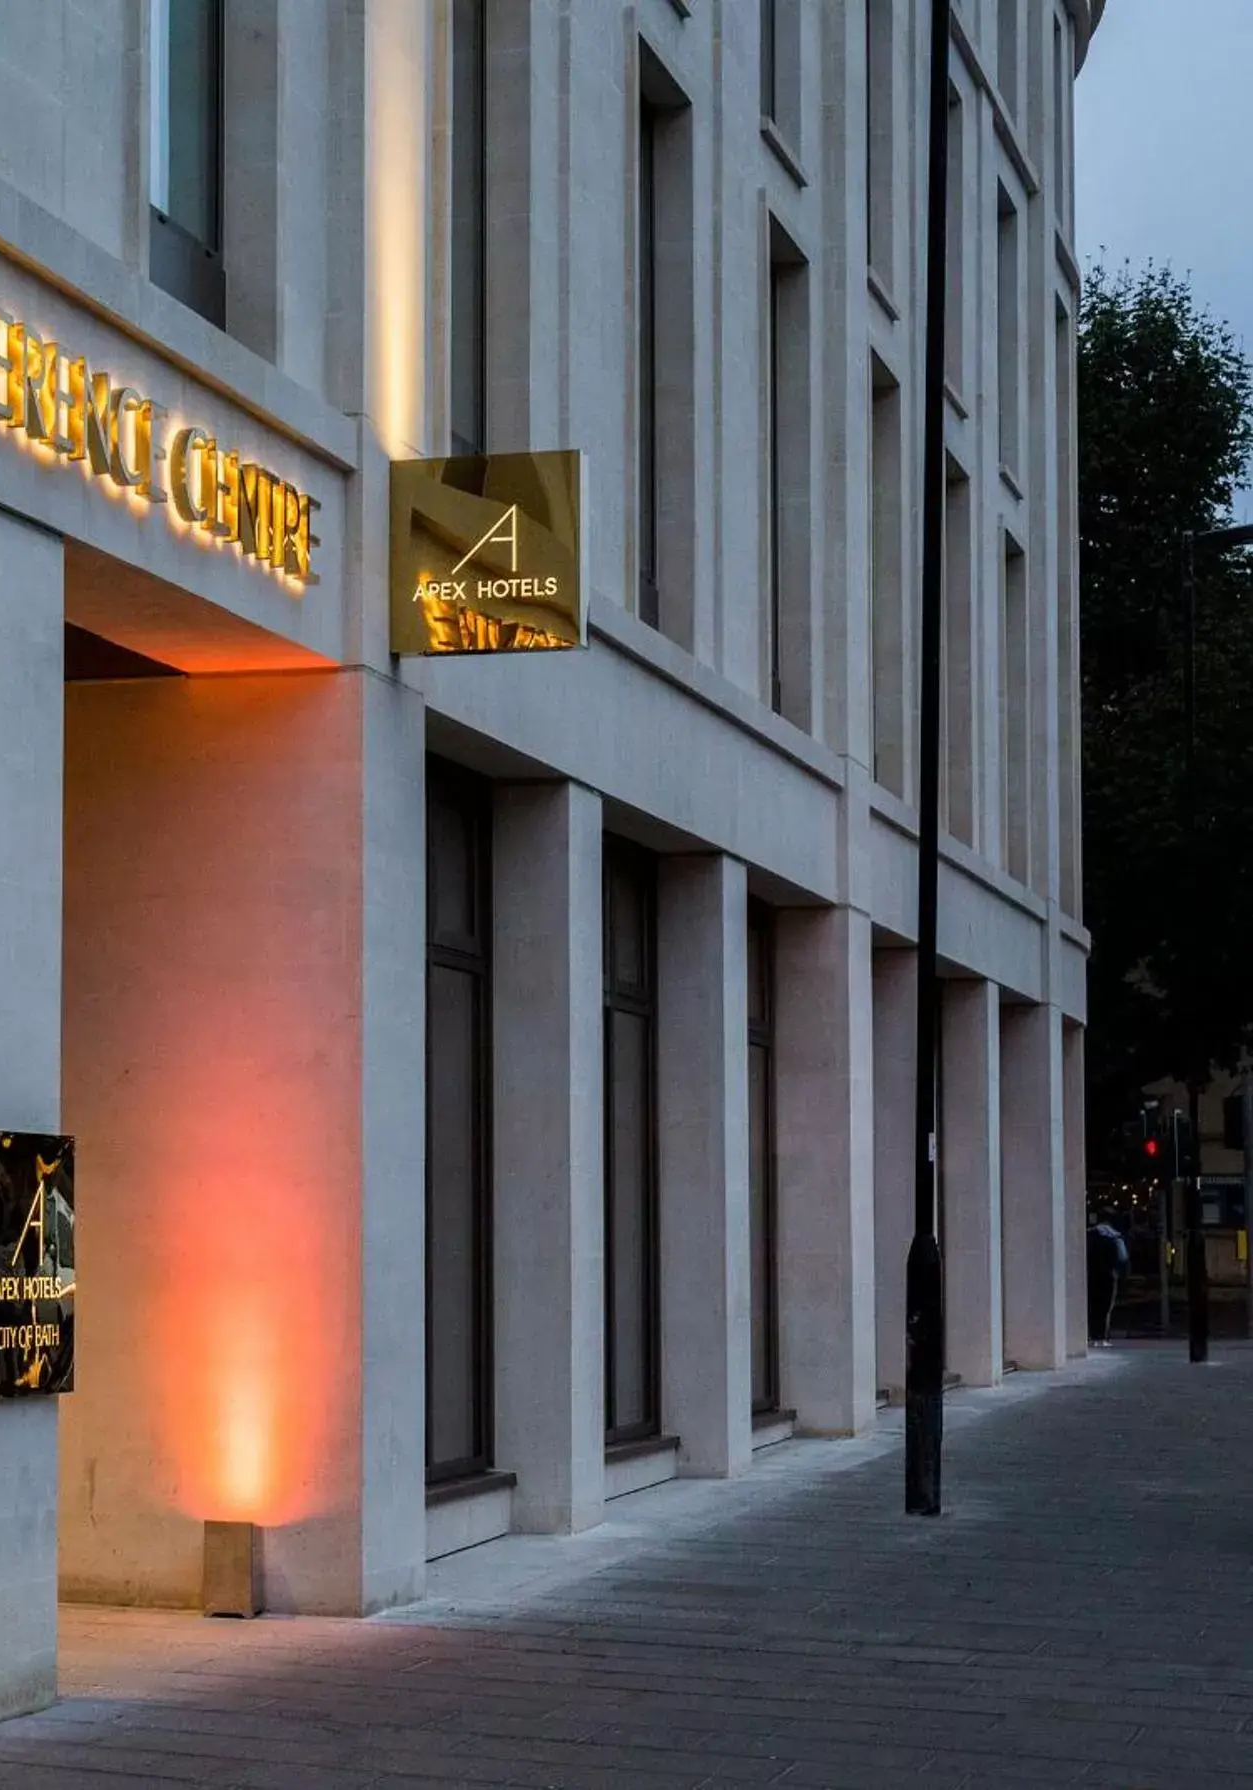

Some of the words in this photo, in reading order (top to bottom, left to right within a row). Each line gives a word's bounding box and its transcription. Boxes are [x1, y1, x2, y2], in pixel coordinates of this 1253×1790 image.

[170, 427, 321, 585] CENTRE
[412, 582, 466, 602] APEX
[478, 577, 558, 598] HOTELS
[23, 1276, 61, 1300] HOTELS
[18, 1325, 33, 1348] OF
[35, 1323, 59, 1347] BATH
